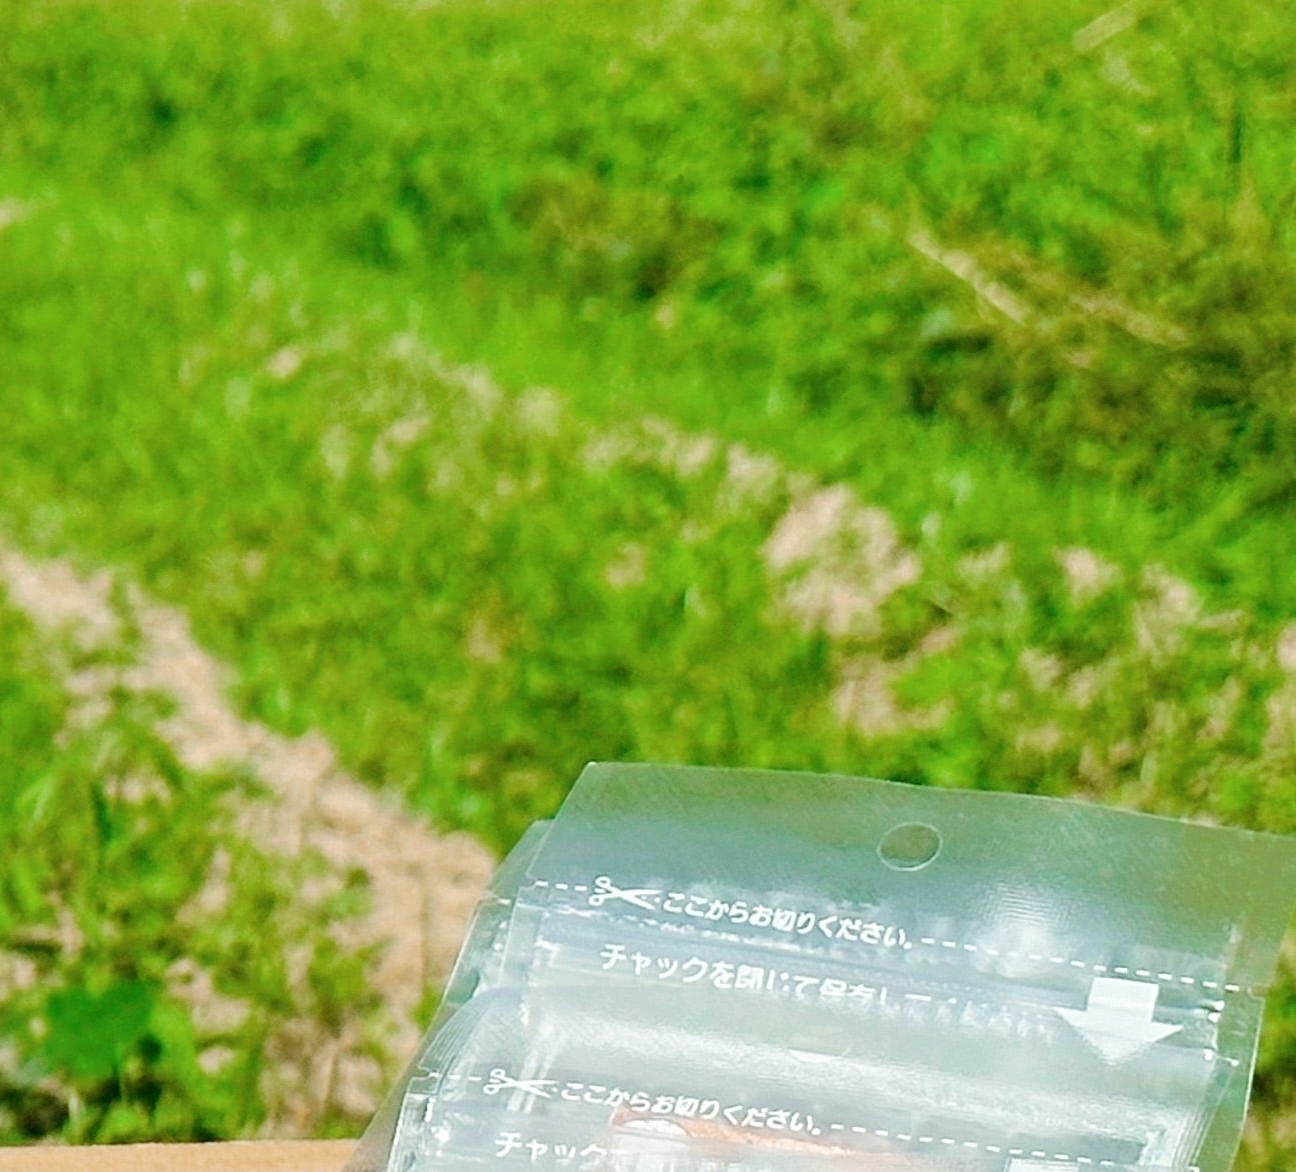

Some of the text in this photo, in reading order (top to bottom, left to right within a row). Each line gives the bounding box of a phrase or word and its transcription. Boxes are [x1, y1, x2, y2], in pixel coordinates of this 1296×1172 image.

[662, 892, 913, 949] ここからお切りください。
[560, 1081, 821, 1136] ここからお切りください。
